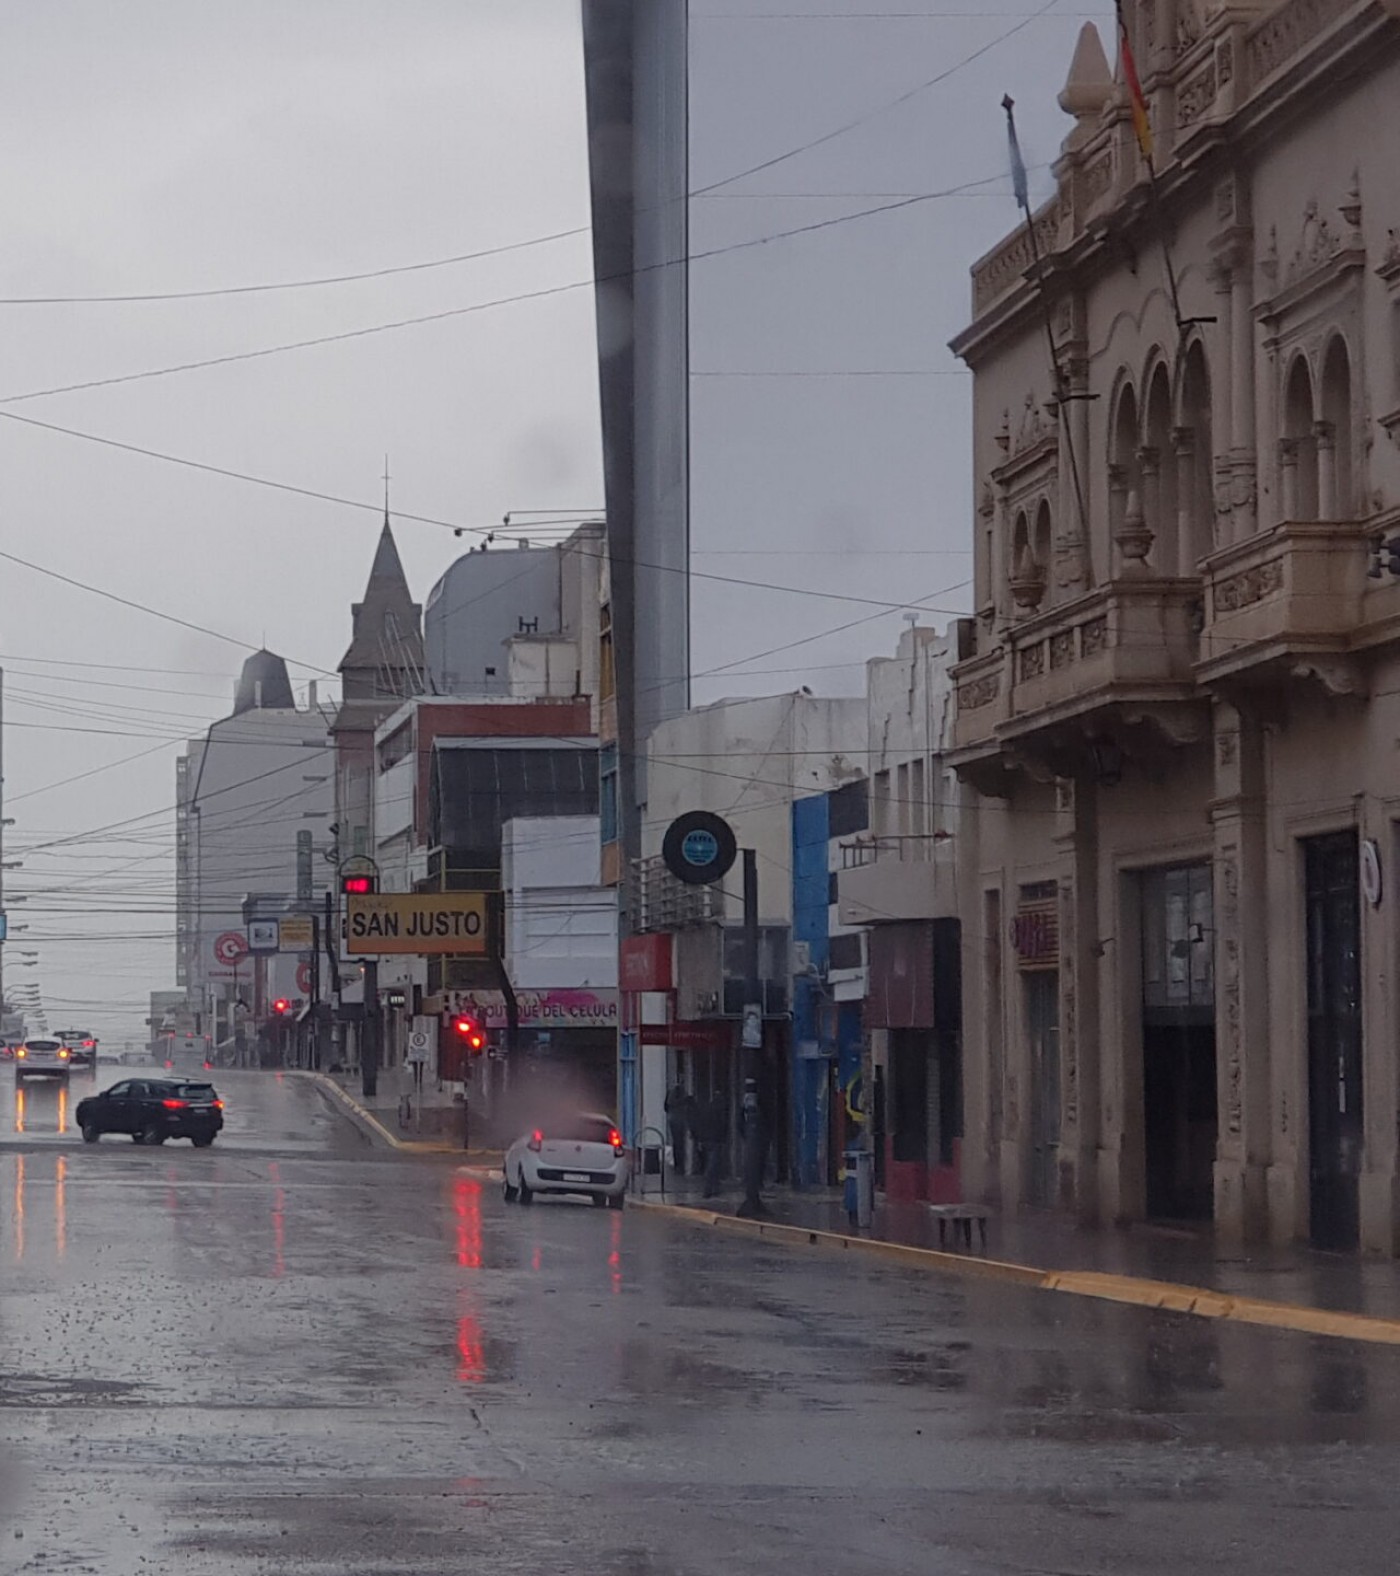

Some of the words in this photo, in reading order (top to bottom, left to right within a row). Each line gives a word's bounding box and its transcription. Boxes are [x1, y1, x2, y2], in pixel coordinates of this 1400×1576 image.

[351, 911, 399, 937] SAN
[406, 910, 482, 937] JUSTO
[543, 1004, 566, 1018] DEL
